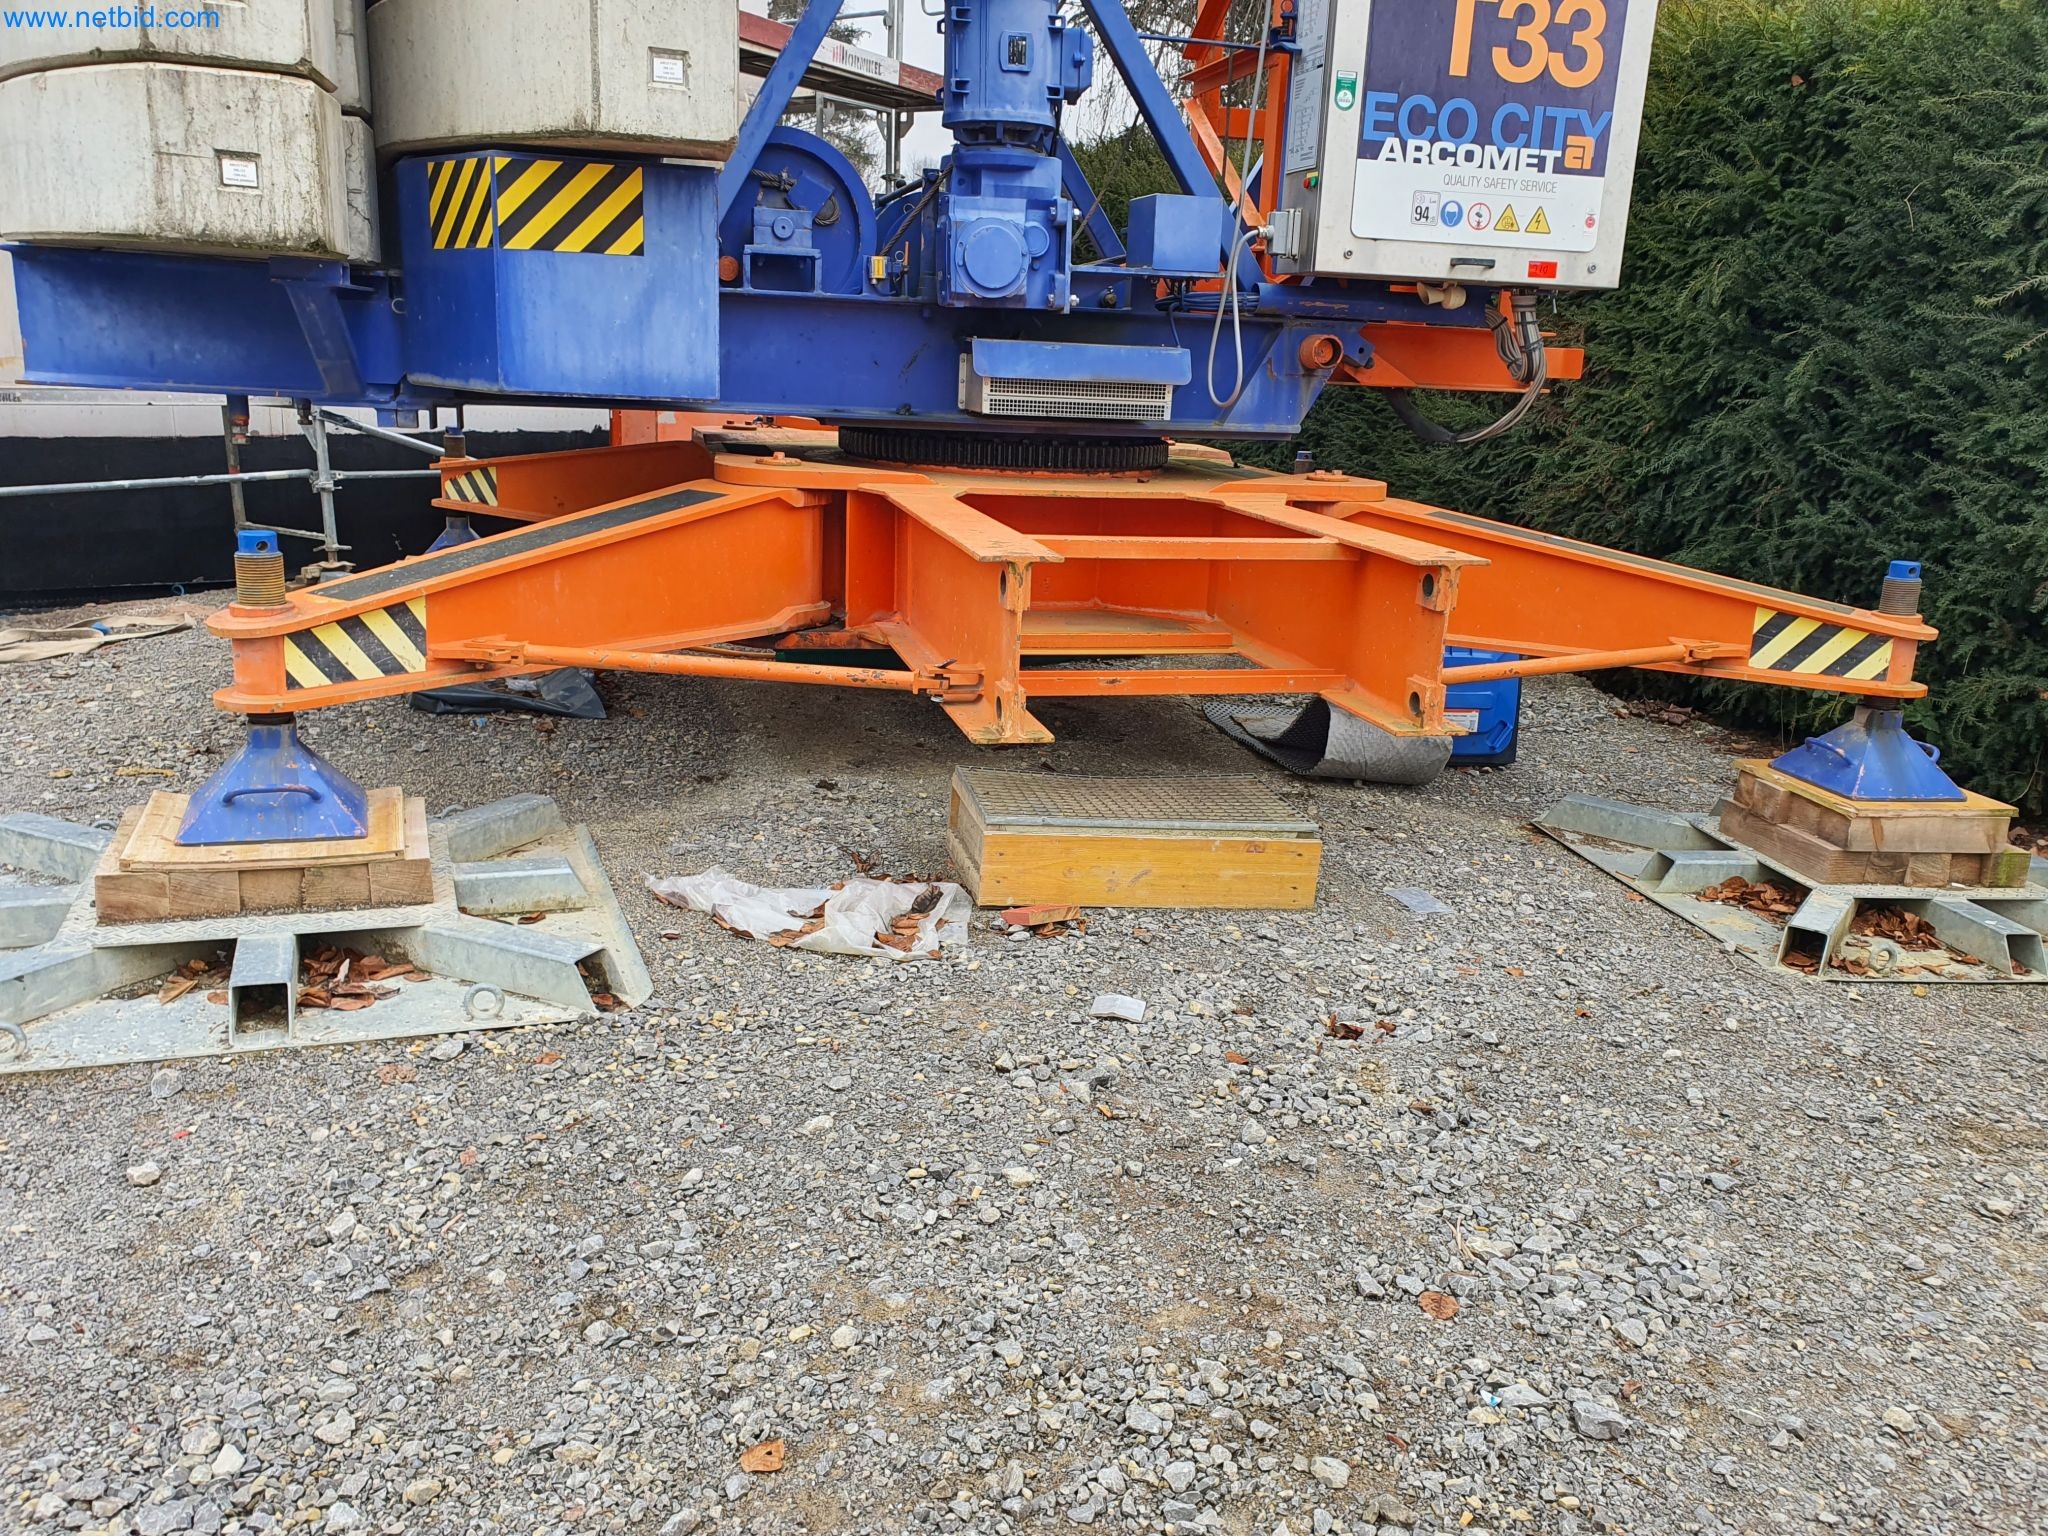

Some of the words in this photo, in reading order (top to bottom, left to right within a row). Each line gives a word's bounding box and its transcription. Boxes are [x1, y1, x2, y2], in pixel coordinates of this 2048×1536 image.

[1363, 91, 1478, 147] ECO
[1491, 102, 1612, 153] CITY
[1377, 137, 1562, 174] ARCOMET
[1443, 173, 1481, 187] QUALITY
[1484, 176, 1517, 190] SAFETY
[1520, 179, 1557, 194] SERVICE
[1414, 204, 1430, 222] 94
